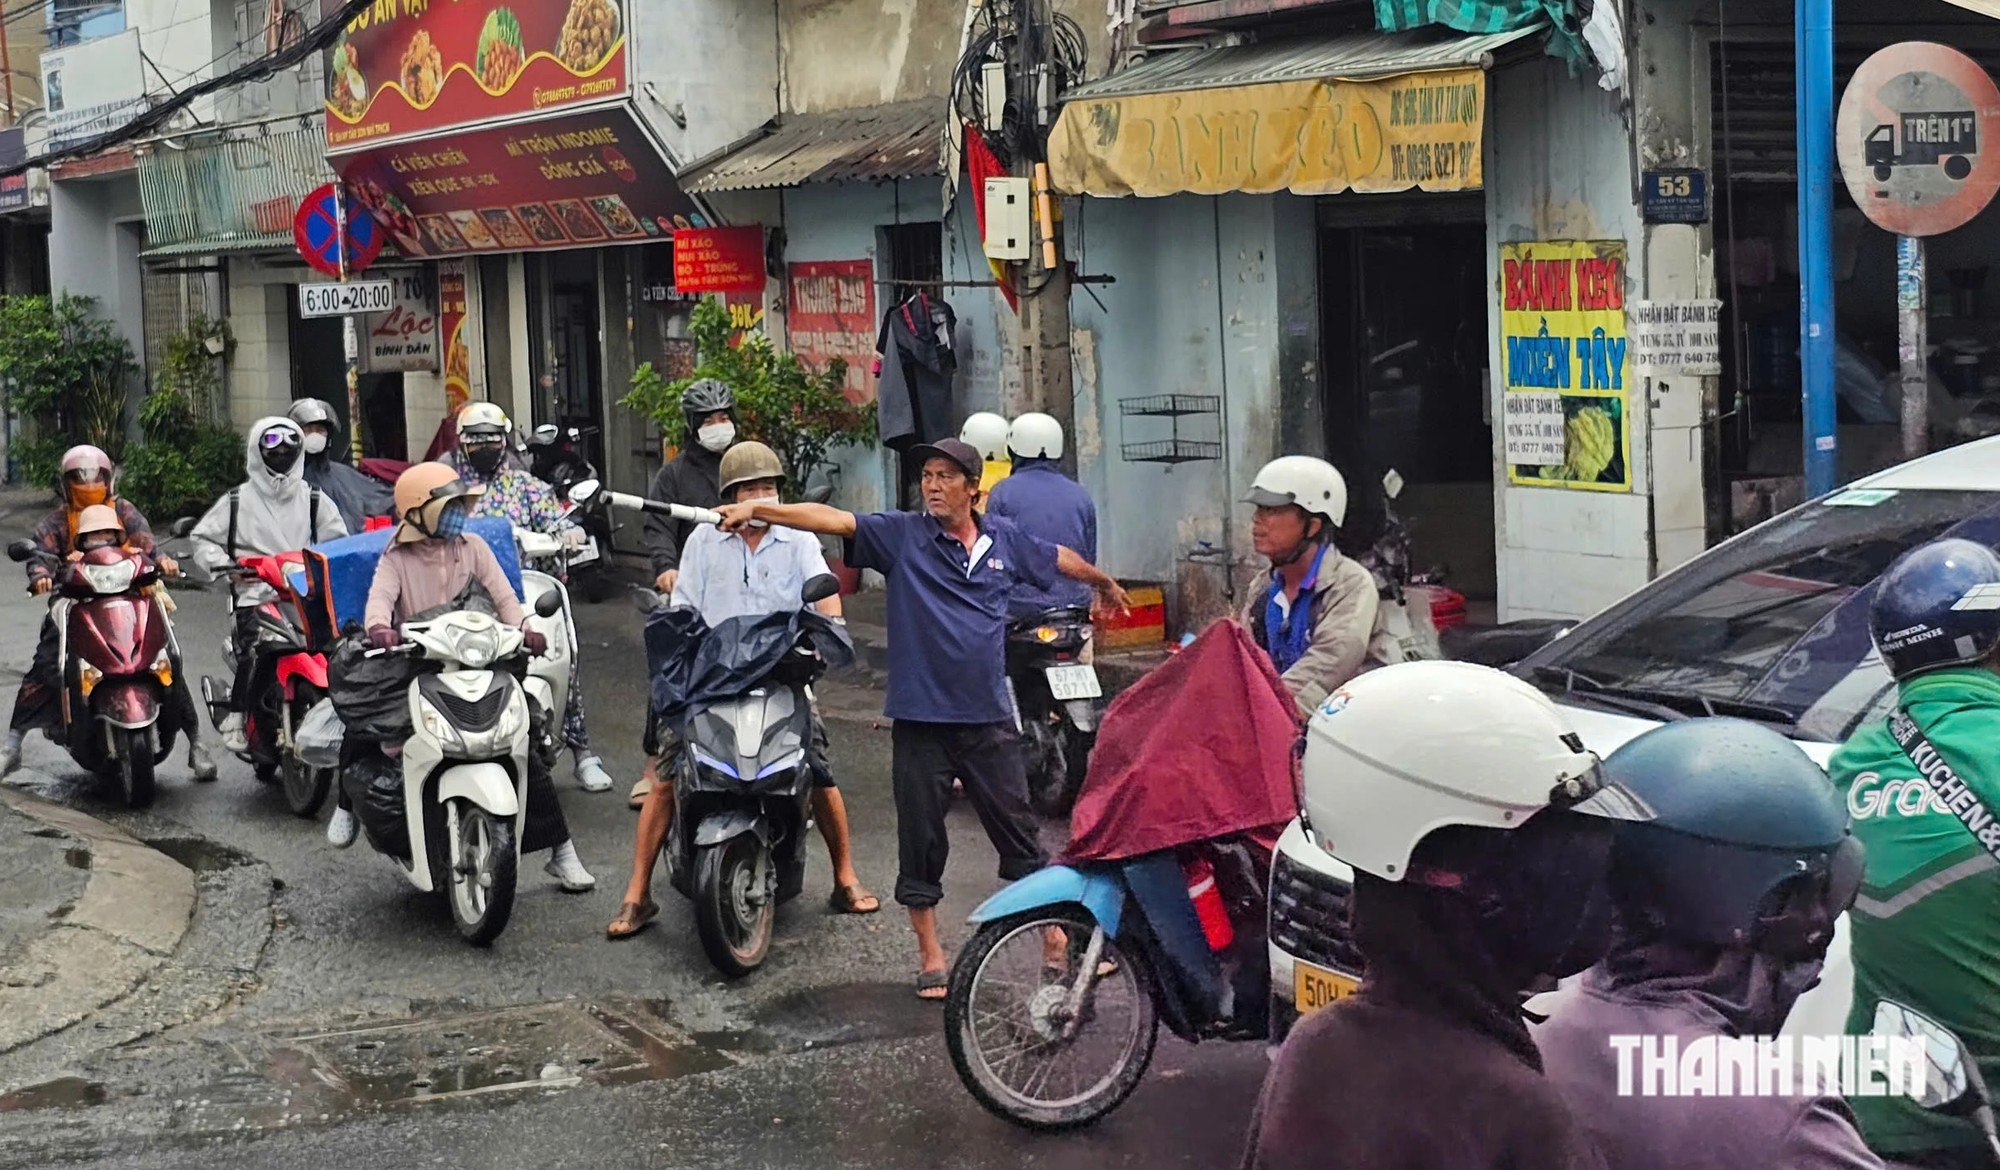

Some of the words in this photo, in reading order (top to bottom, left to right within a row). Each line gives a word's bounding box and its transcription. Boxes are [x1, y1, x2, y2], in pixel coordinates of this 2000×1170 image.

[557, 127, 619, 149] INDOMIE
[1905, 114, 1949, 142] TRÊN
[1658, 175, 1690, 197] 53
[1503, 248, 1572, 311] BÁNH
[372, 305, 434, 341] Lộc
[729, 303, 754, 329] 30K
[1638, 302, 1662, 326] NHẬN
[1663, 302, 1679, 328] ĐẶT
[1681, 302, 1705, 323] BÁNH
[1506, 315, 1571, 389] MIỀN
[1576, 326, 1626, 390] TÂY
[1658, 353, 1681, 365] 0777
[1684, 352, 1703, 364] 640
[1521, 442, 1539, 454] 0777
[1905, 627, 1944, 645] MINH
